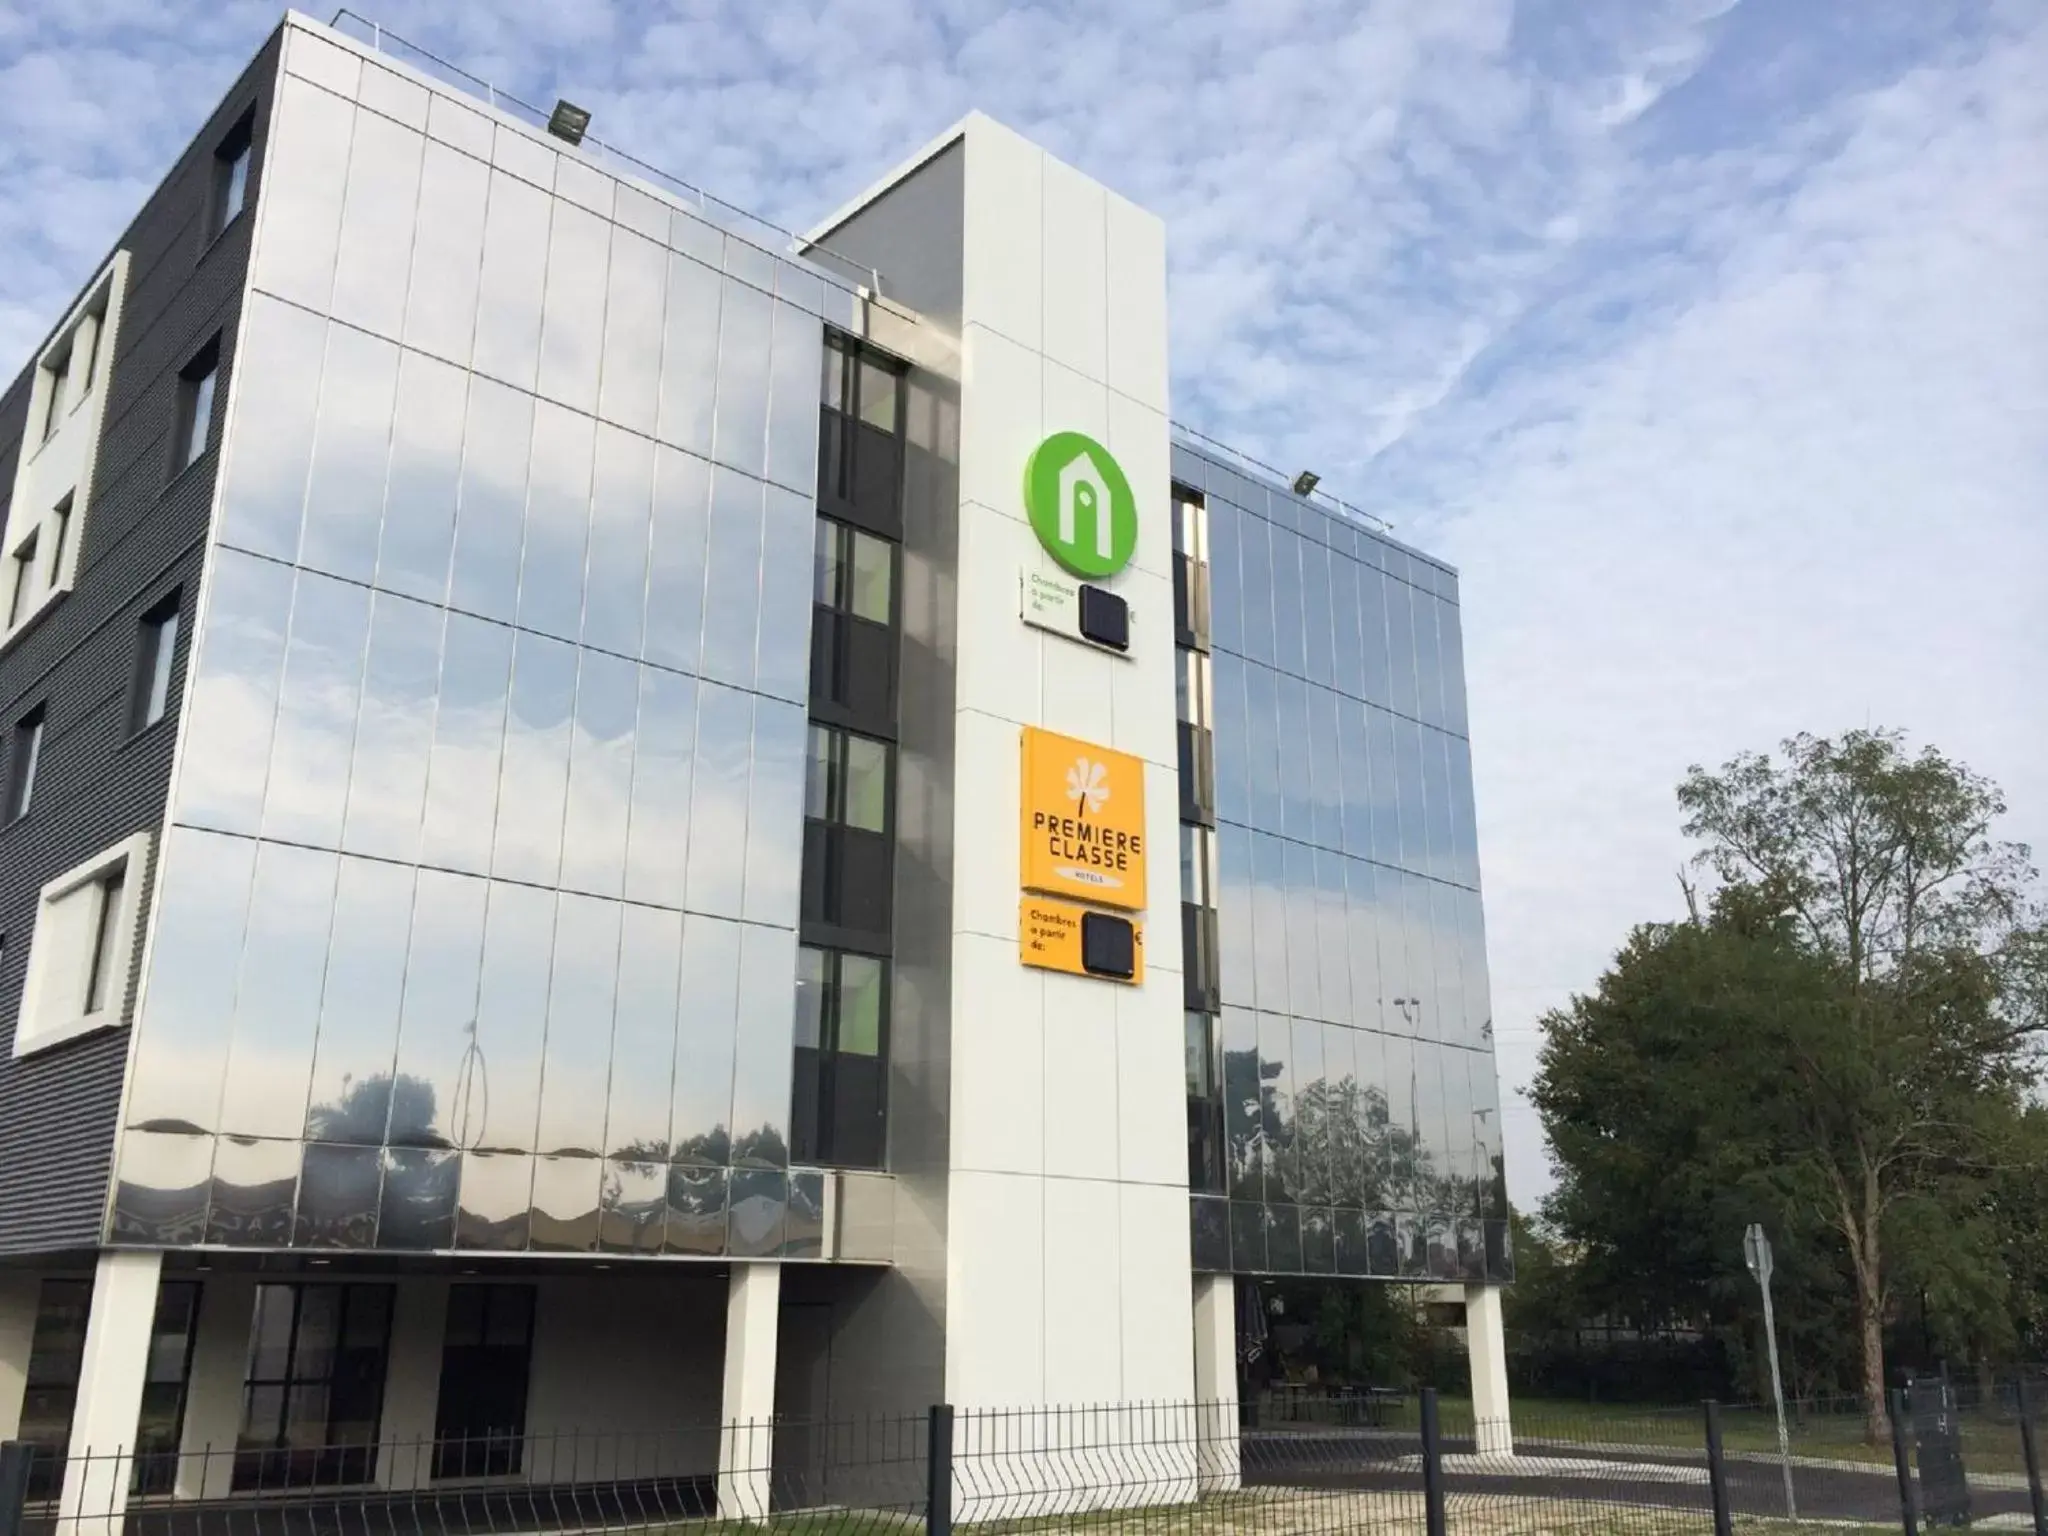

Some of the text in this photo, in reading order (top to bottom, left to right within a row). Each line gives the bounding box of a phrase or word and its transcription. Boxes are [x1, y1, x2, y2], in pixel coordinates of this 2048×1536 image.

[1034, 811, 1141, 854] PREMIERE
[1050, 836, 1127, 871] CLASSE
[1075, 871, 1104, 884] HOTELS
[1031, 909, 1077, 928] Chambres
[1040, 927, 1066, 939] partir
